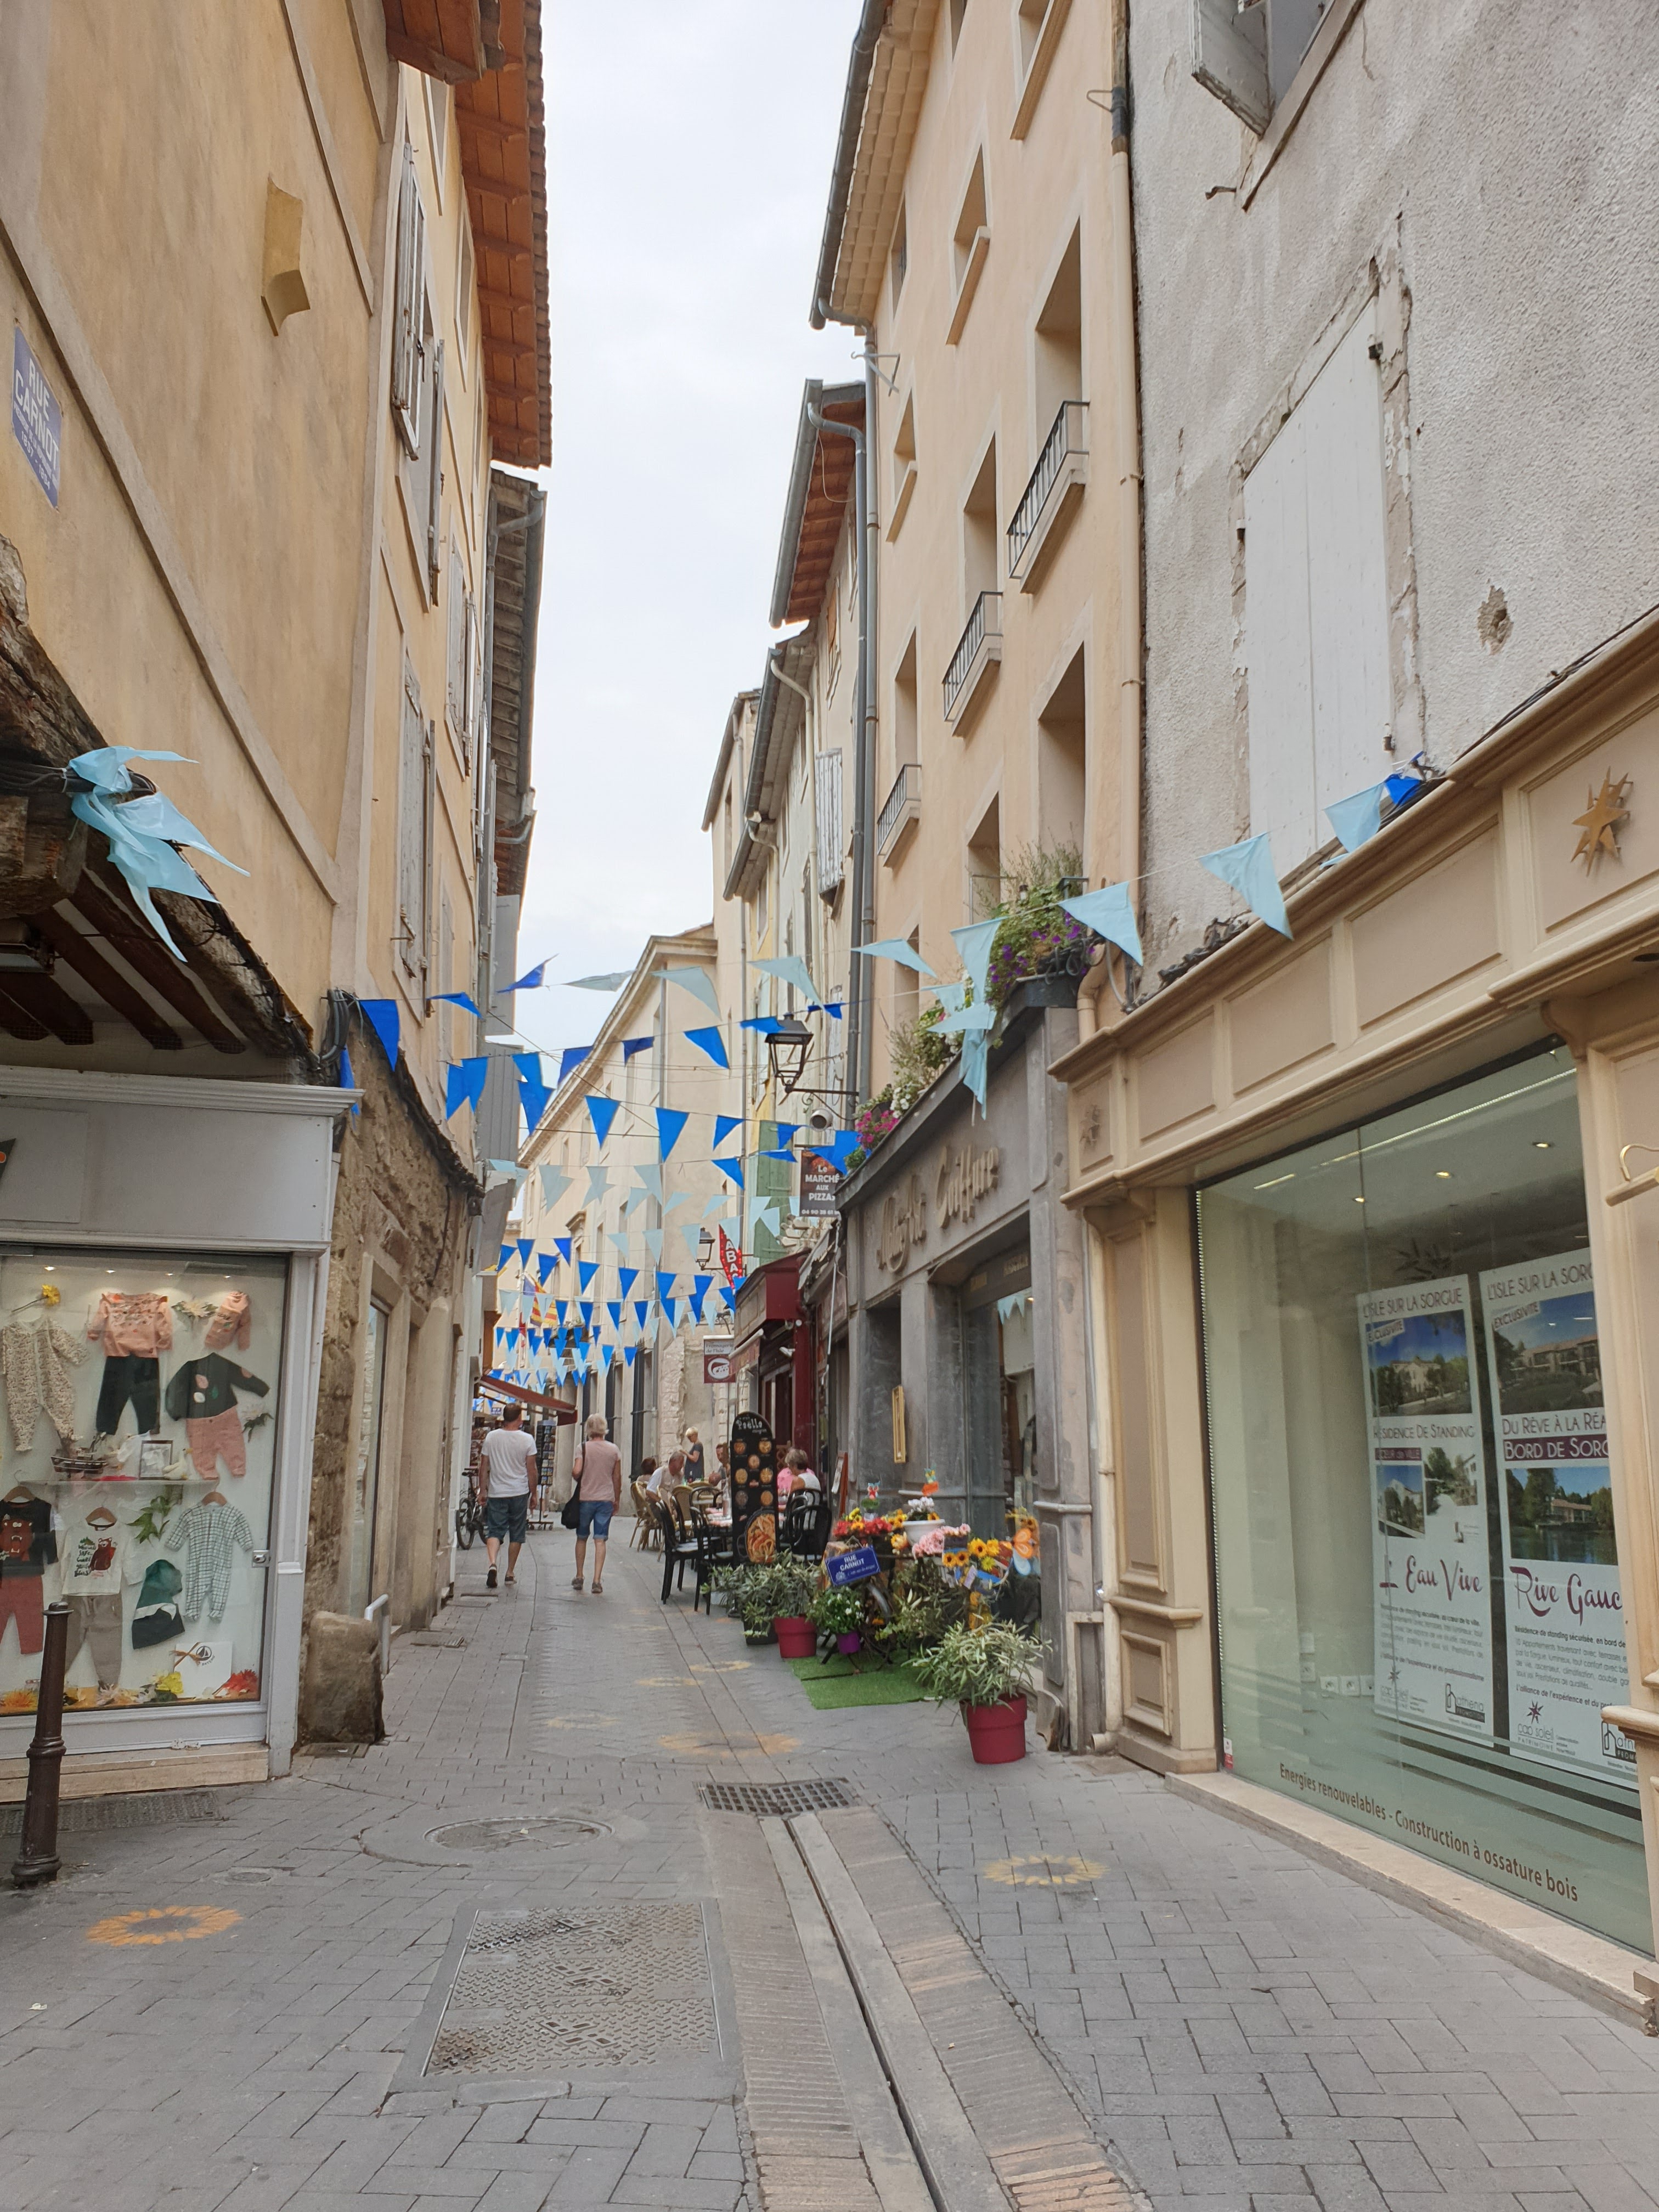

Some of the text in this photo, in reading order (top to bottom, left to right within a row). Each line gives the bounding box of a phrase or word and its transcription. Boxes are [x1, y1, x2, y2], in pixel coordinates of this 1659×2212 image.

[29, 358, 50, 421] RUE
[15, 369, 59, 471] CARNOT
[805, 1173, 840, 1183] MARCHÉ
[817, 1164, 827, 1172] Le
[1487, 1279, 1515, 1300] L'ISLE
[1518, 1274, 1539, 1294] SUR
[1542, 1271, 1559, 1288] LA
[1387, 1297, 1404, 1314] SUR
[1407, 1296, 1418, 1311] LA
[1420, 1288, 1463, 1308] SORGUE
[1554, 1414, 1562, 1432] À
[1505, 1441, 1543, 1459] BORD
[839, 1558, 865, 1572] CARNOT
[844, 1554, 856, 1563] RUE
[1440, 1559, 1483, 1601] Vive
[1509, 1566, 1559, 1617] Rive
[1604, 1638, 1617, 1646] bord
[1280, 1763, 1316, 1791] Energies
[1318, 1782, 1386, 1820] renouvelables
[1395, 1810, 1470, 1855] Construction
[1473, 1839, 1480, 1860] à
[1483, 1849, 1542, 1887] ossature
[1546, 1869, 1578, 1902] bois
